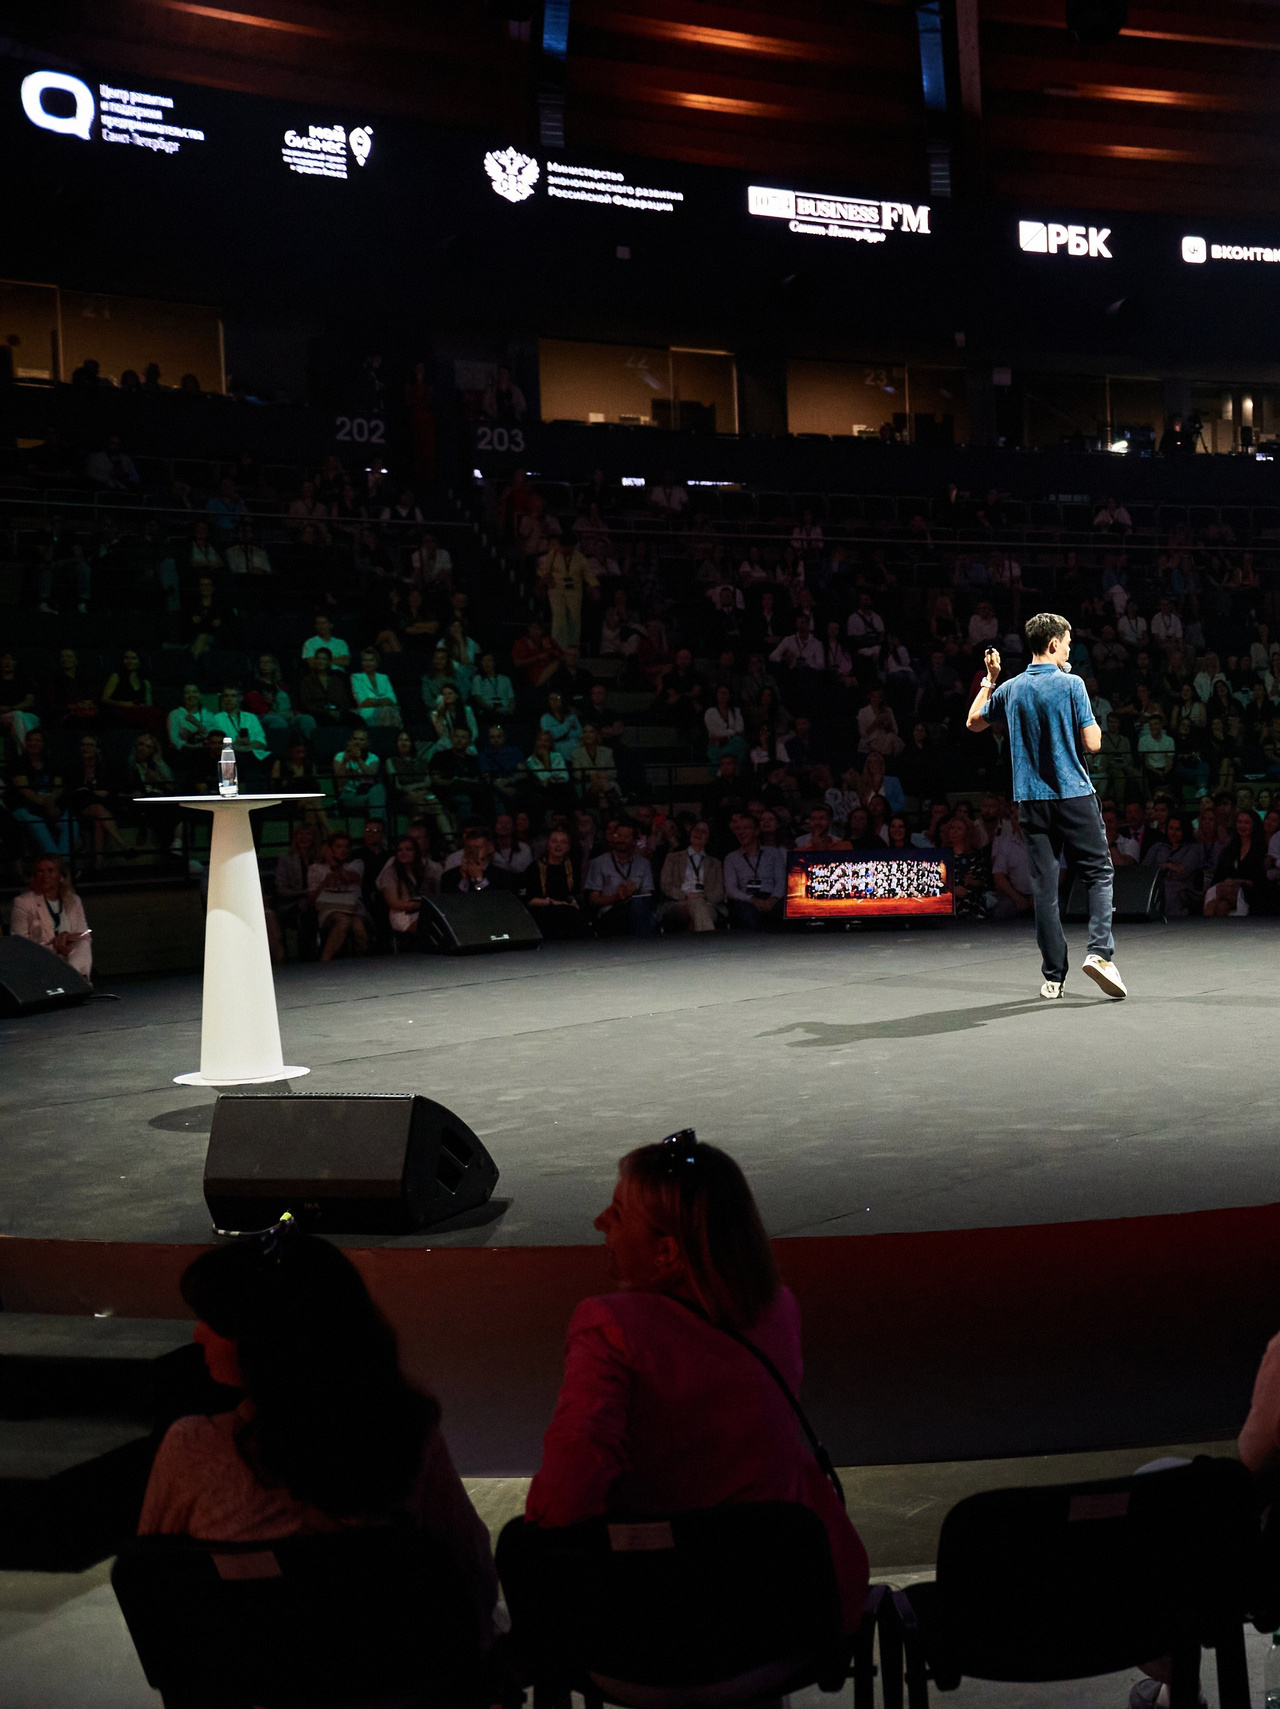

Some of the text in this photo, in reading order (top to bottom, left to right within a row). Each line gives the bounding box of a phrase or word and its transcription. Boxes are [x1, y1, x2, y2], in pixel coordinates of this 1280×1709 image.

[284, 130, 347, 155] бизнес
[547, 161, 625, 182] Министерство
[548, 185, 674, 212] Российской Федерации
[634, 186, 684, 201] развития
[797, 198, 880, 223] BUSINESS
[880, 202, 931, 234] FM
[1047, 223, 1113, 259] РБК
[335, 416, 386, 444] 202
[476, 426, 525, 452] 203
